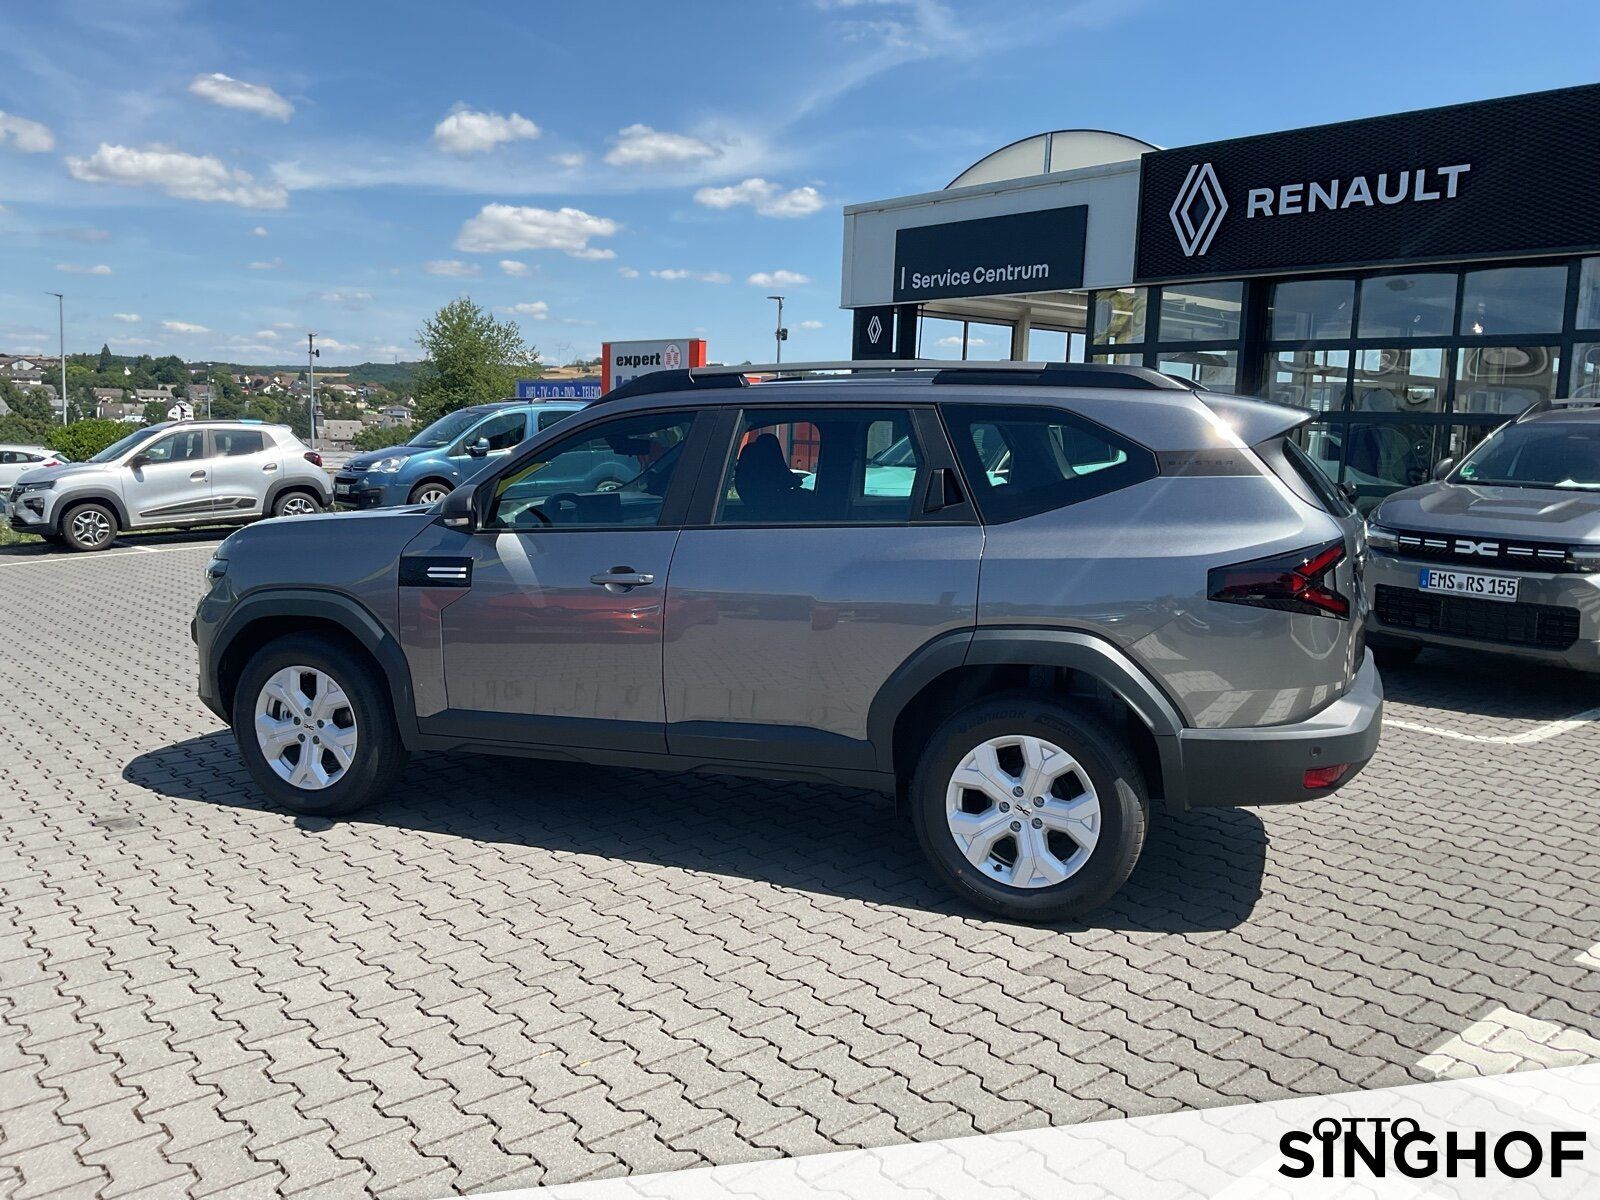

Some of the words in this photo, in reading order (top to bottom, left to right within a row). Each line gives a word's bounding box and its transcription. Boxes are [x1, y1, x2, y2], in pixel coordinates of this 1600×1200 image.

[1247, 164, 1471, 218] RENAULT
[912, 269, 971, 289] Service
[973, 263, 1049, 284] Centrum
[616, 353, 661, 368] expert
[540, 386, 548, 398] TV
[1429, 572, 1455, 589] EMS
[1465, 577, 1485, 593] RS
[1488, 579, 1516, 596] 155
